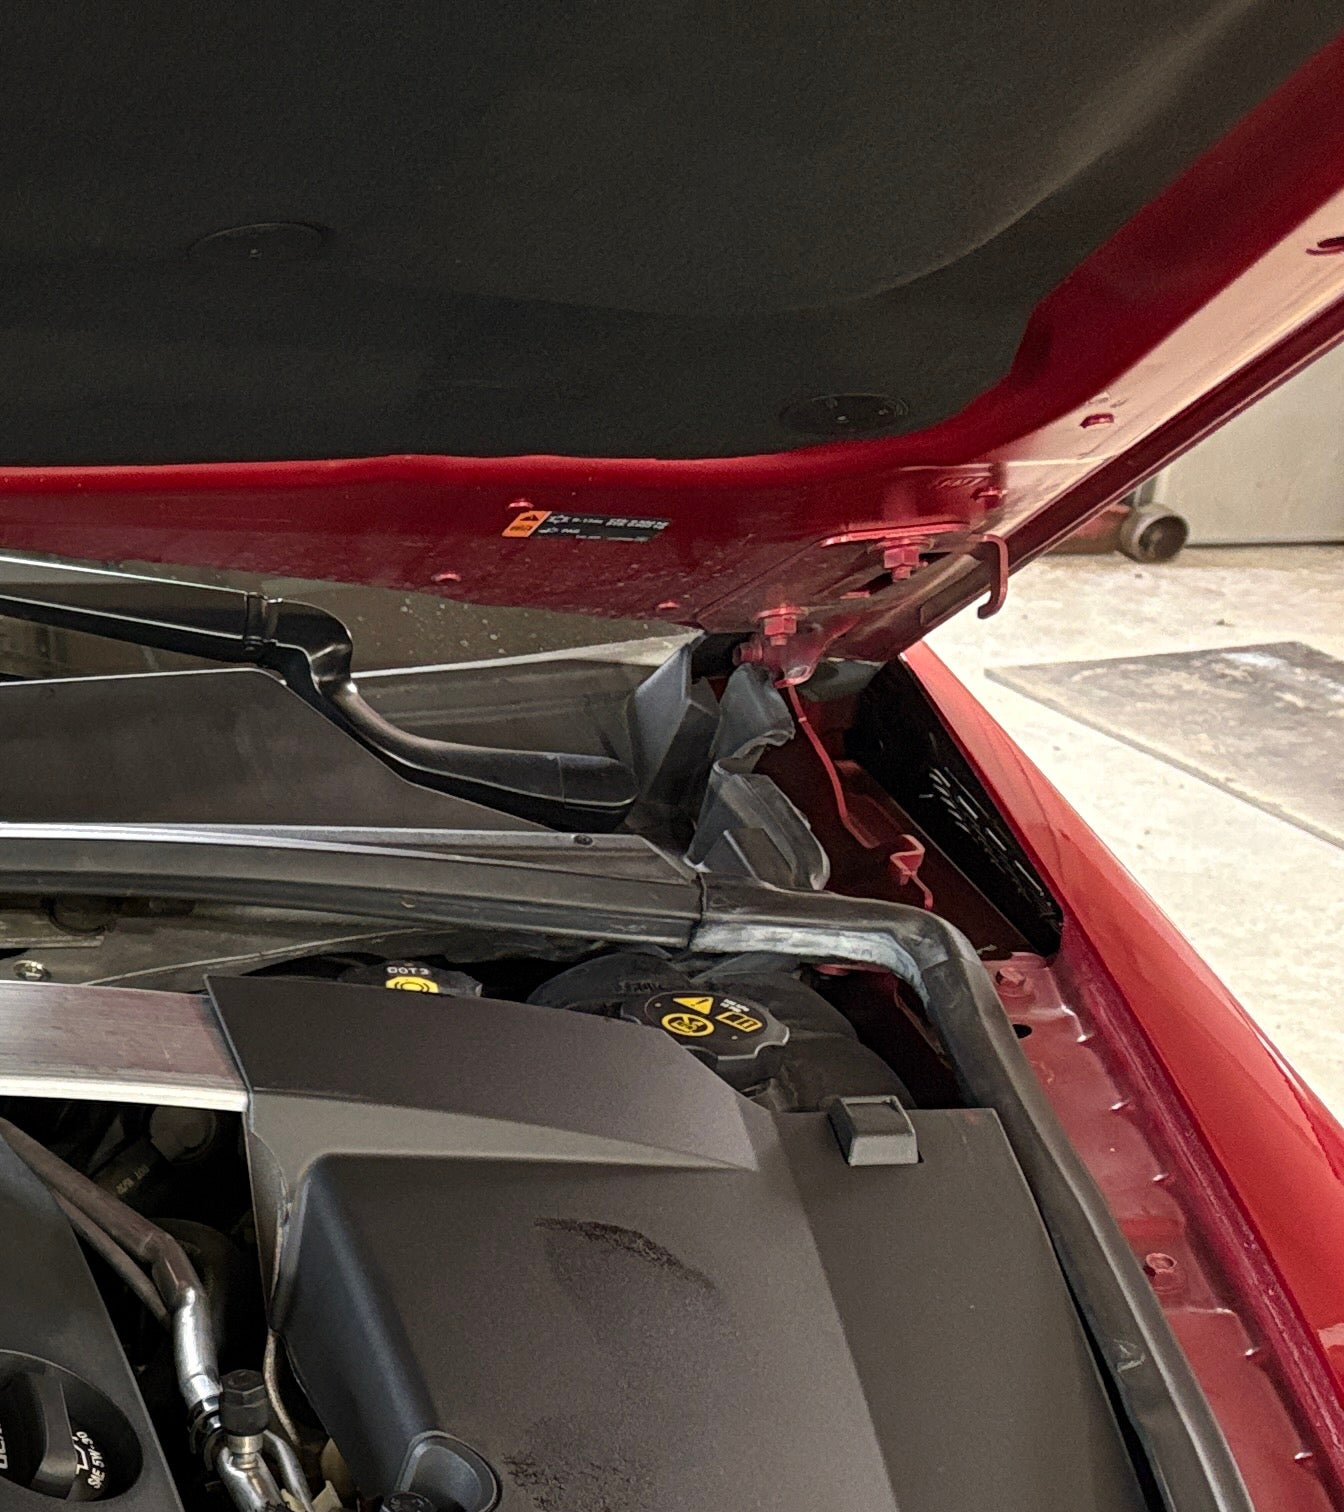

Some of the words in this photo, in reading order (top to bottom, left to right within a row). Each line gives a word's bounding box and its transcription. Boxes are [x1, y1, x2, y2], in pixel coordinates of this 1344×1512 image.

[386, 966, 417, 975] DOT
[75, 1431, 106, 1469] 5W-30
[87, 1467, 106, 1490] SAE
